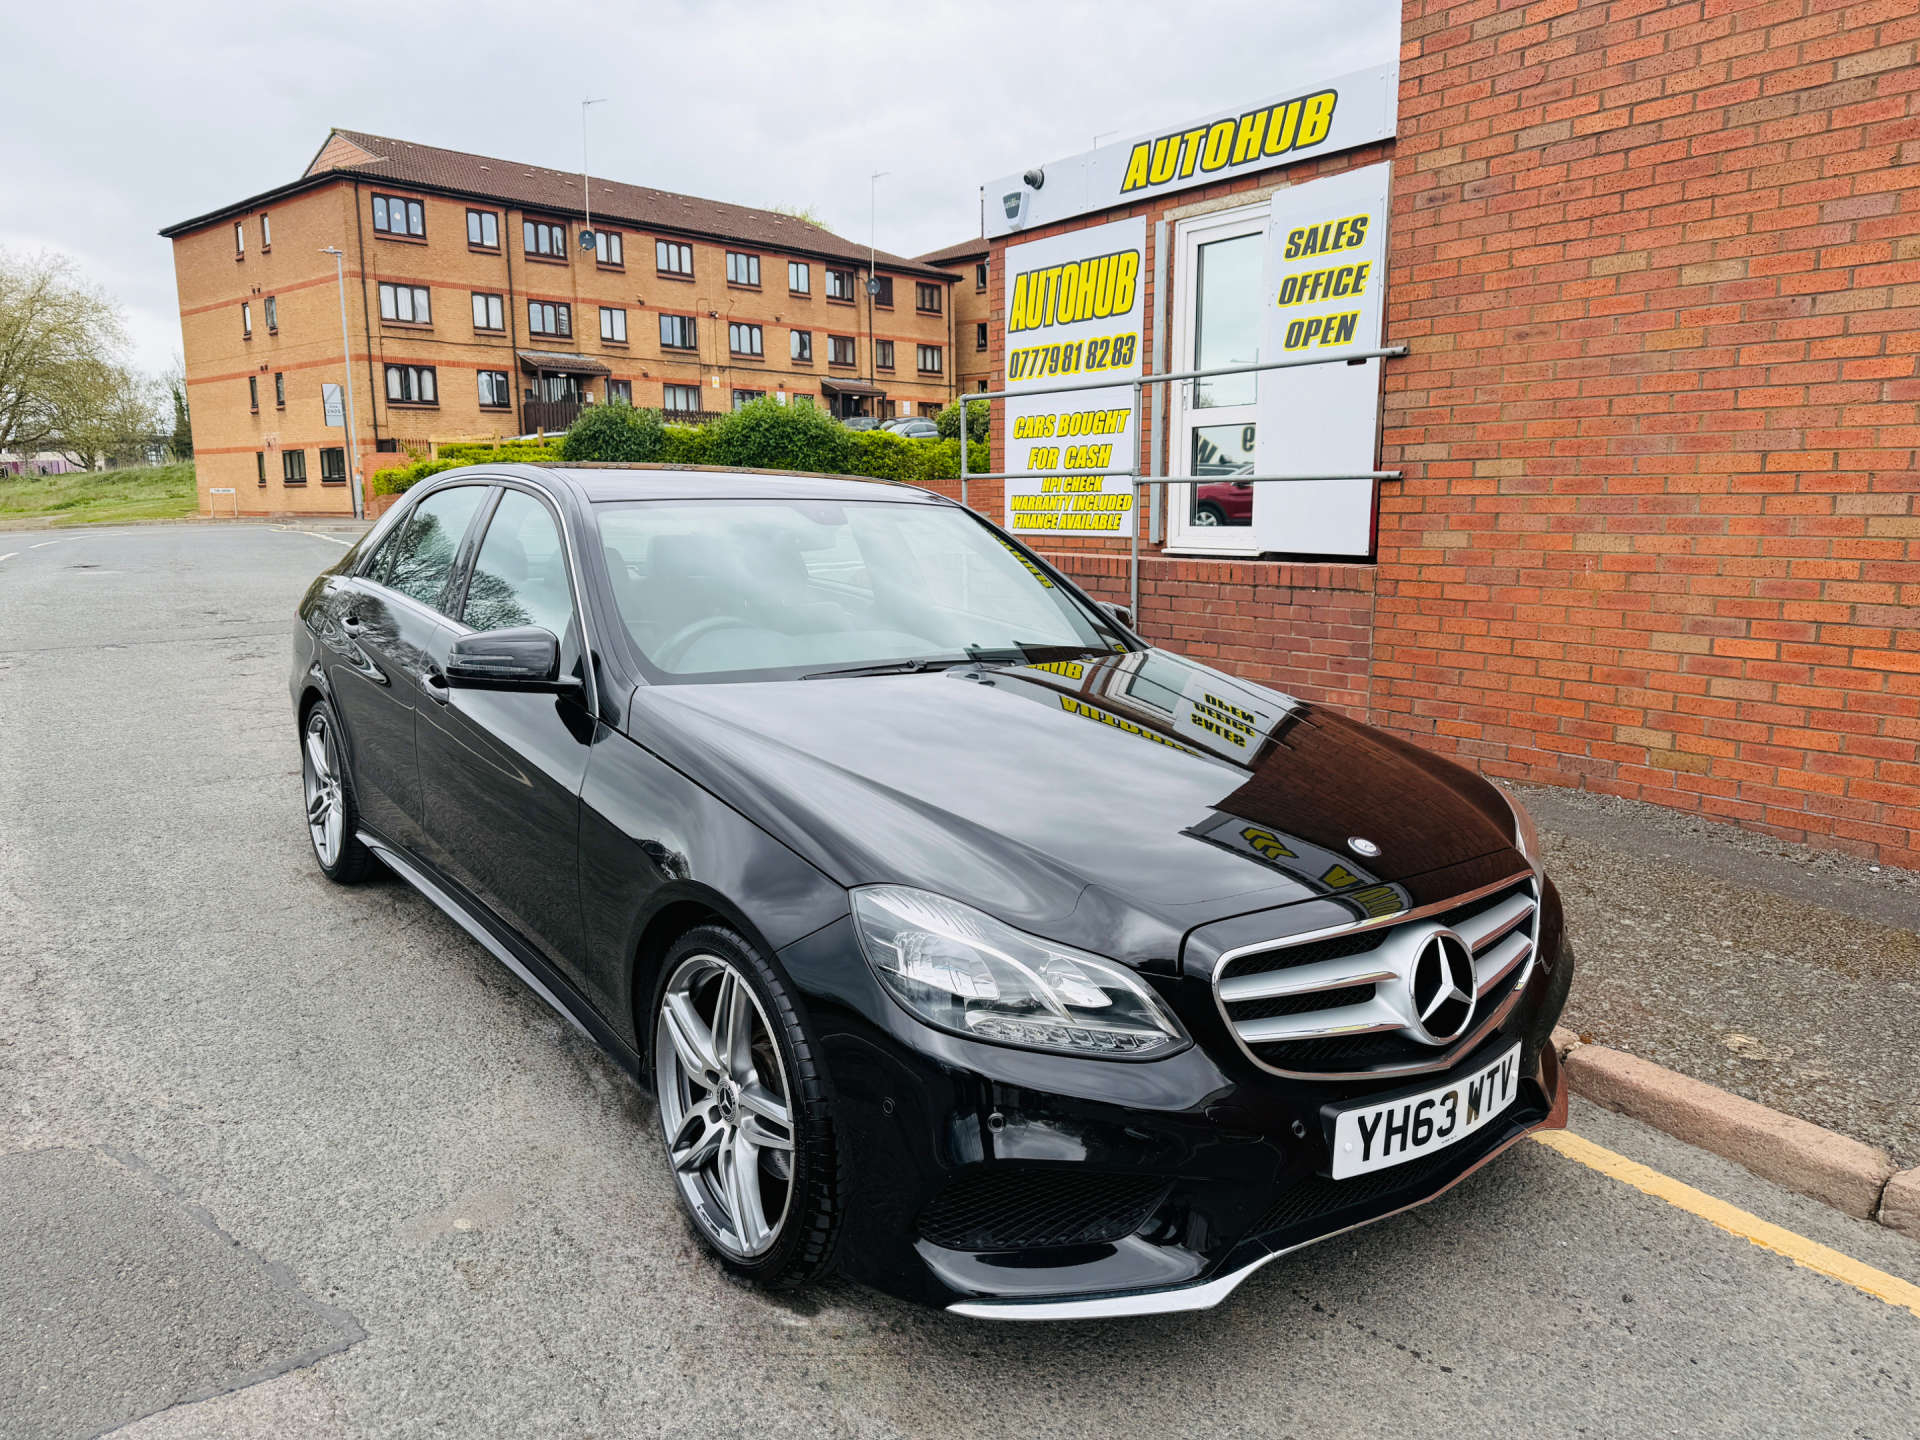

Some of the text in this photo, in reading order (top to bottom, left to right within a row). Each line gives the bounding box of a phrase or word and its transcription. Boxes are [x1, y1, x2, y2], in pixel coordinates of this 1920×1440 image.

[1120, 88, 1339, 194] AUTOHUB
[1283, 213, 1370, 261] SALES
[1008, 249, 1140, 333] AUTOHUB
[1277, 260, 1373, 308] OFFICE
[1283, 310, 1362, 351] OPEN
[1013, 408, 1131, 439] CARS BOUGHT
[1027, 444, 1112, 470] FOR CASH
[1010, 494, 1133, 511] WARRANTY INCLUDED
[1041, 475, 1104, 493] HPI CHECK
[1013, 513, 1122, 530] FINANCE AVAILABLE
[1357, 1054, 1514, 1162] YH63 WTV
